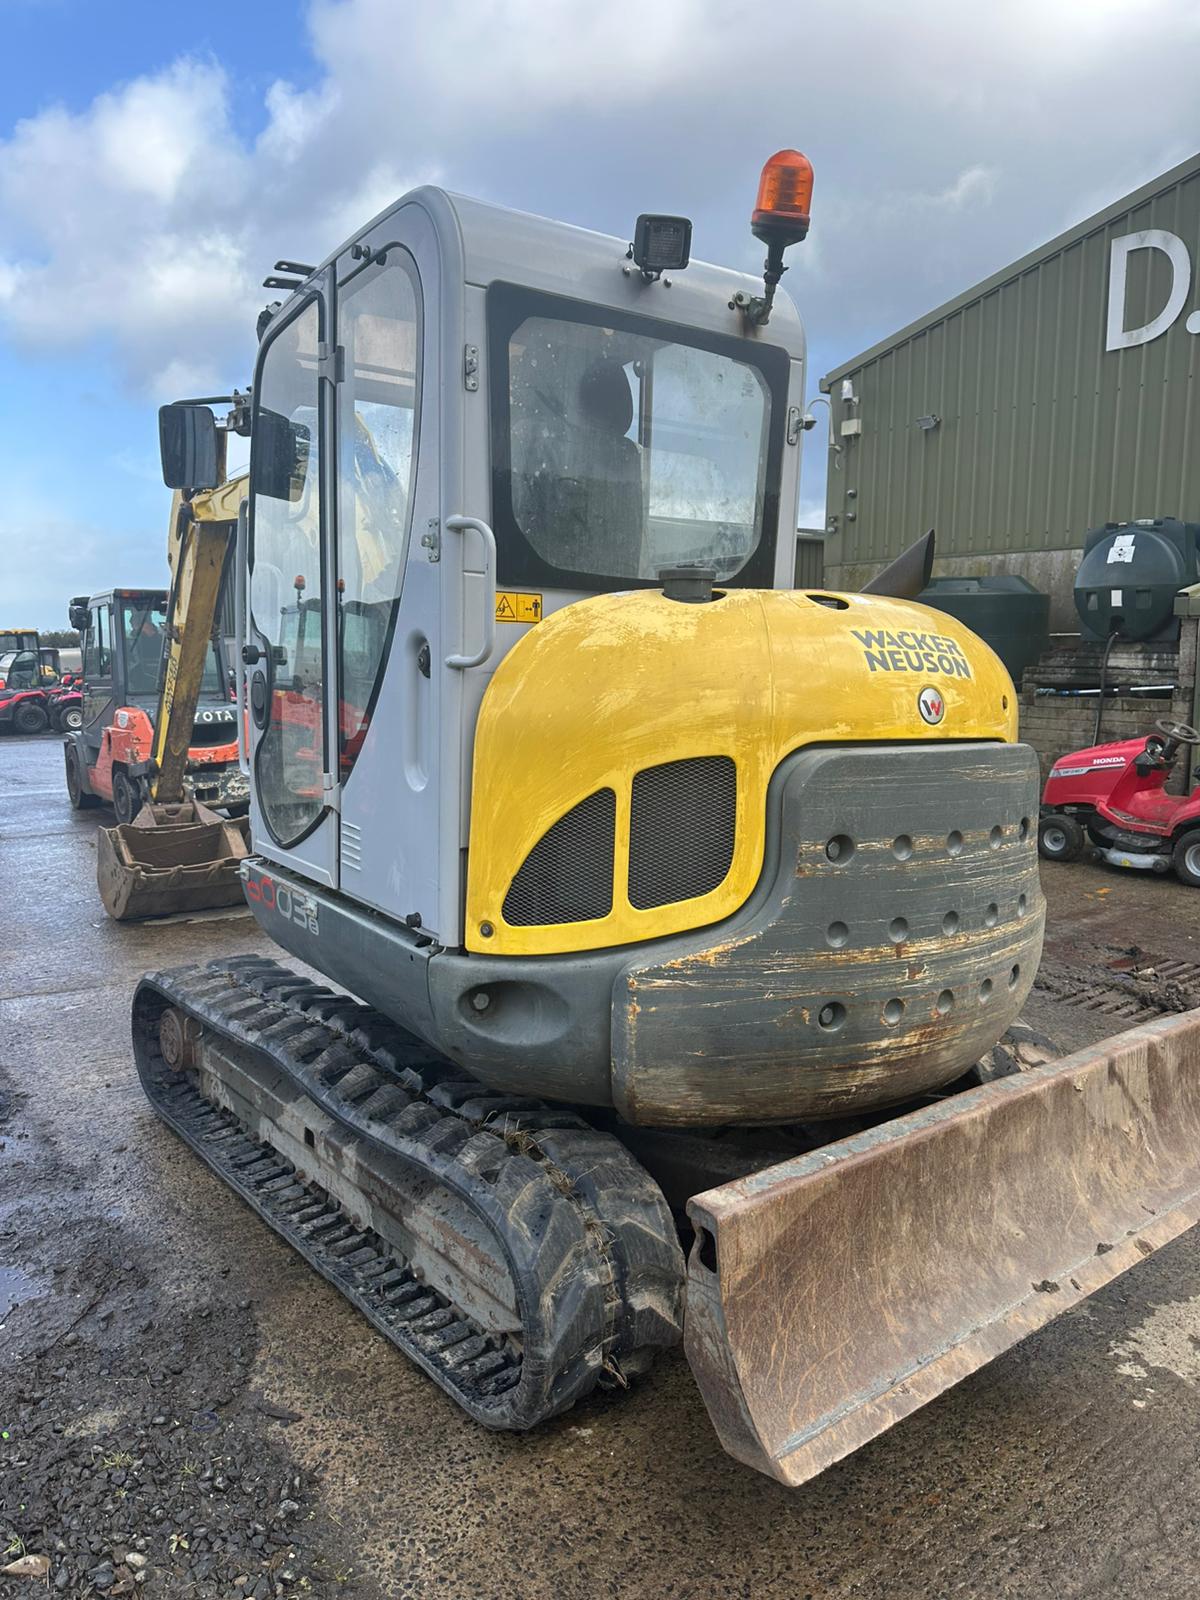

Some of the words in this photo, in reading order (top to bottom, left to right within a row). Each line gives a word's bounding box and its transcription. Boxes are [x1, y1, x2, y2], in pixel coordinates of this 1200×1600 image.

[850, 630, 963, 657] WACKER
[864, 650, 971, 679] NEUSON
[1093, 756, 1126, 765] HONDA
